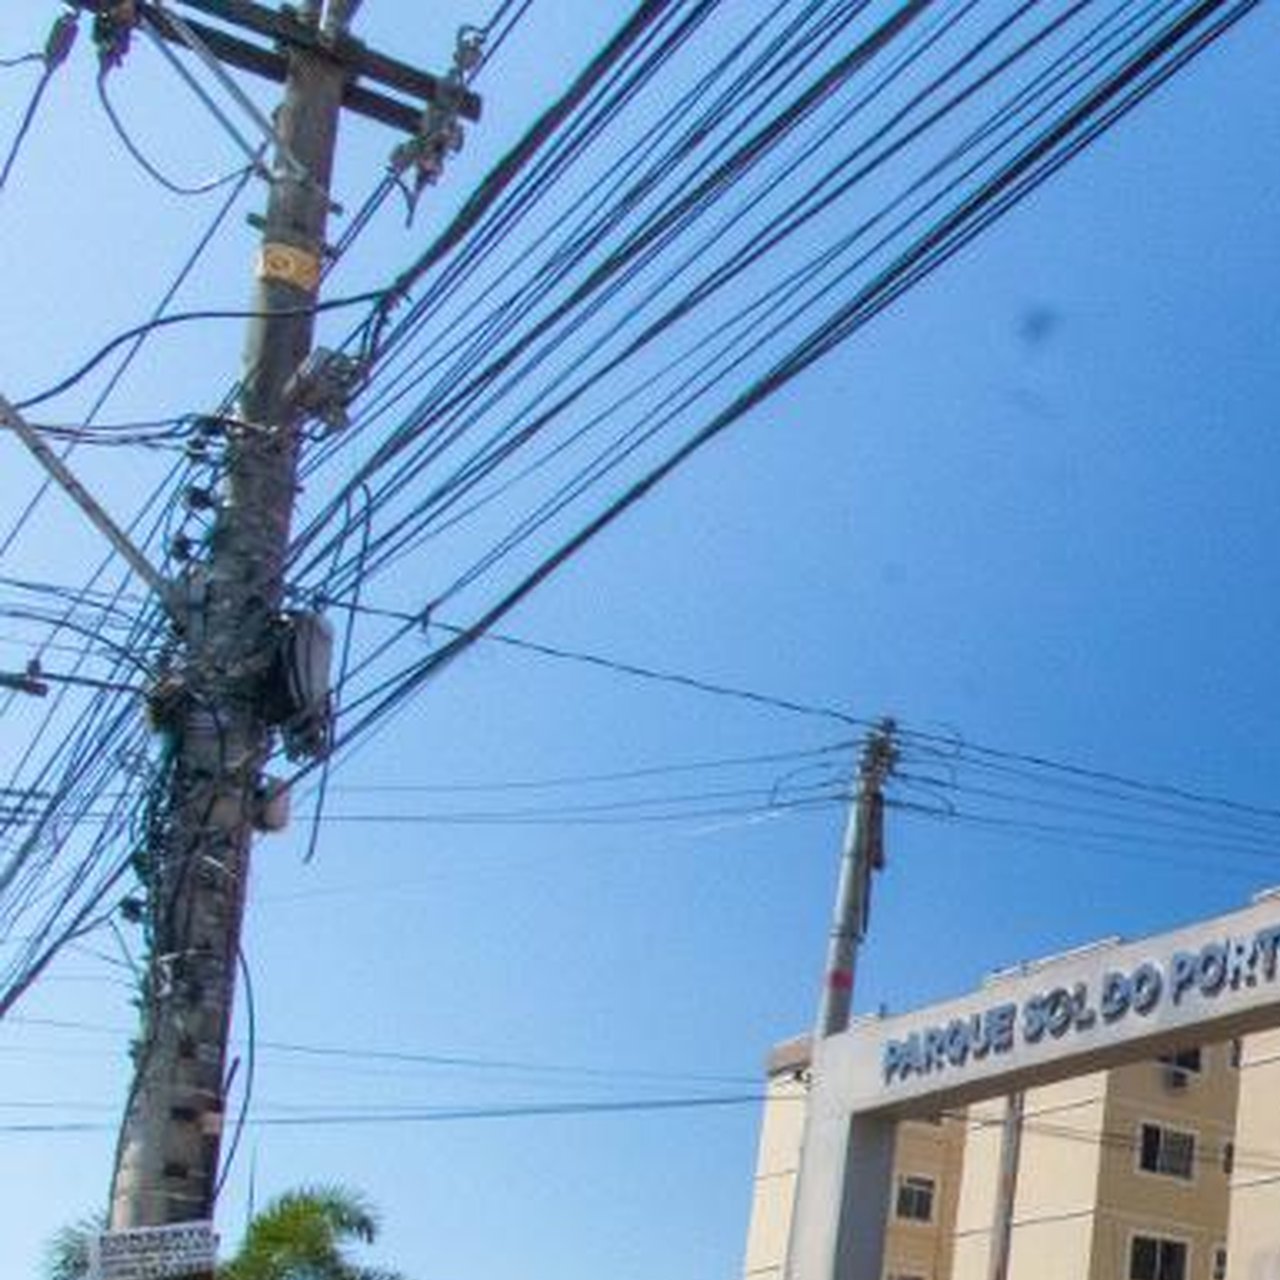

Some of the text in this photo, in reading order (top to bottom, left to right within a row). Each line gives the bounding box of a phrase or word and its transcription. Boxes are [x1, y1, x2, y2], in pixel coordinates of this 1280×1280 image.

[883, 1002, 1016, 1085] PARQUE
[1023, 982, 1097, 1044] SOL
[1101, 961, 1163, 1024] DO
